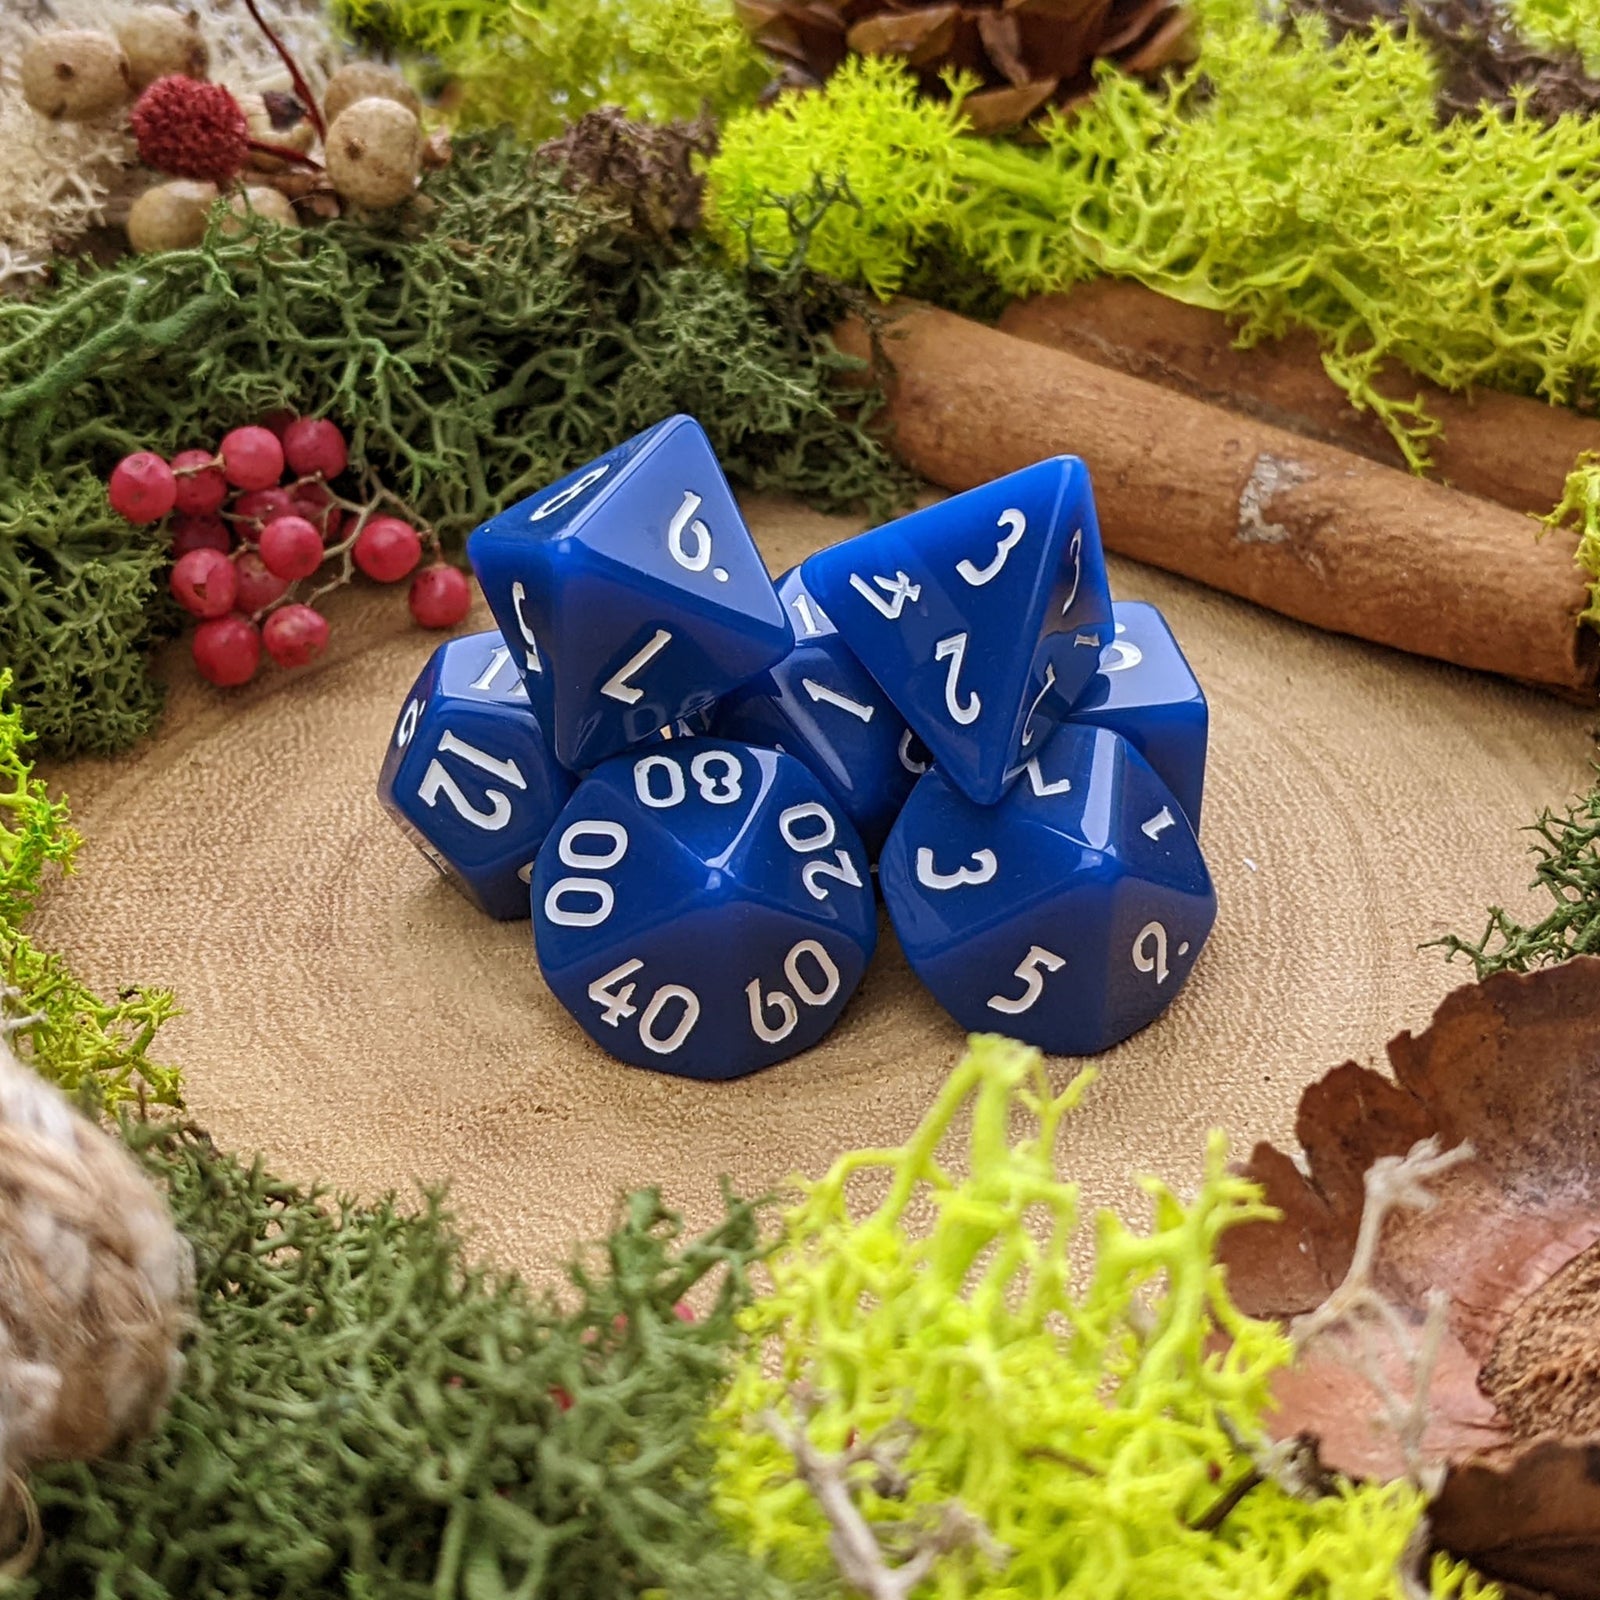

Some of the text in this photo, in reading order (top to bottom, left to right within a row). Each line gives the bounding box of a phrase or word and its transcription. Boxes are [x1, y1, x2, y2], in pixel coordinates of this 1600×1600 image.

[956, 508, 1026, 586] 3
[849, 571, 921, 619] 4
[802, 678, 874, 723] 1
[934, 632, 982, 725] 2
[417, 729, 528, 831] 12
[634, 750, 743, 809] 80
[544, 820, 629, 927] 00
[779, 802, 863, 901] 20
[917, 847, 997, 890] 3
[588, 957, 701, 1054] 40
[744, 939, 841, 1044] 60
[987, 945, 1066, 1014] 5
